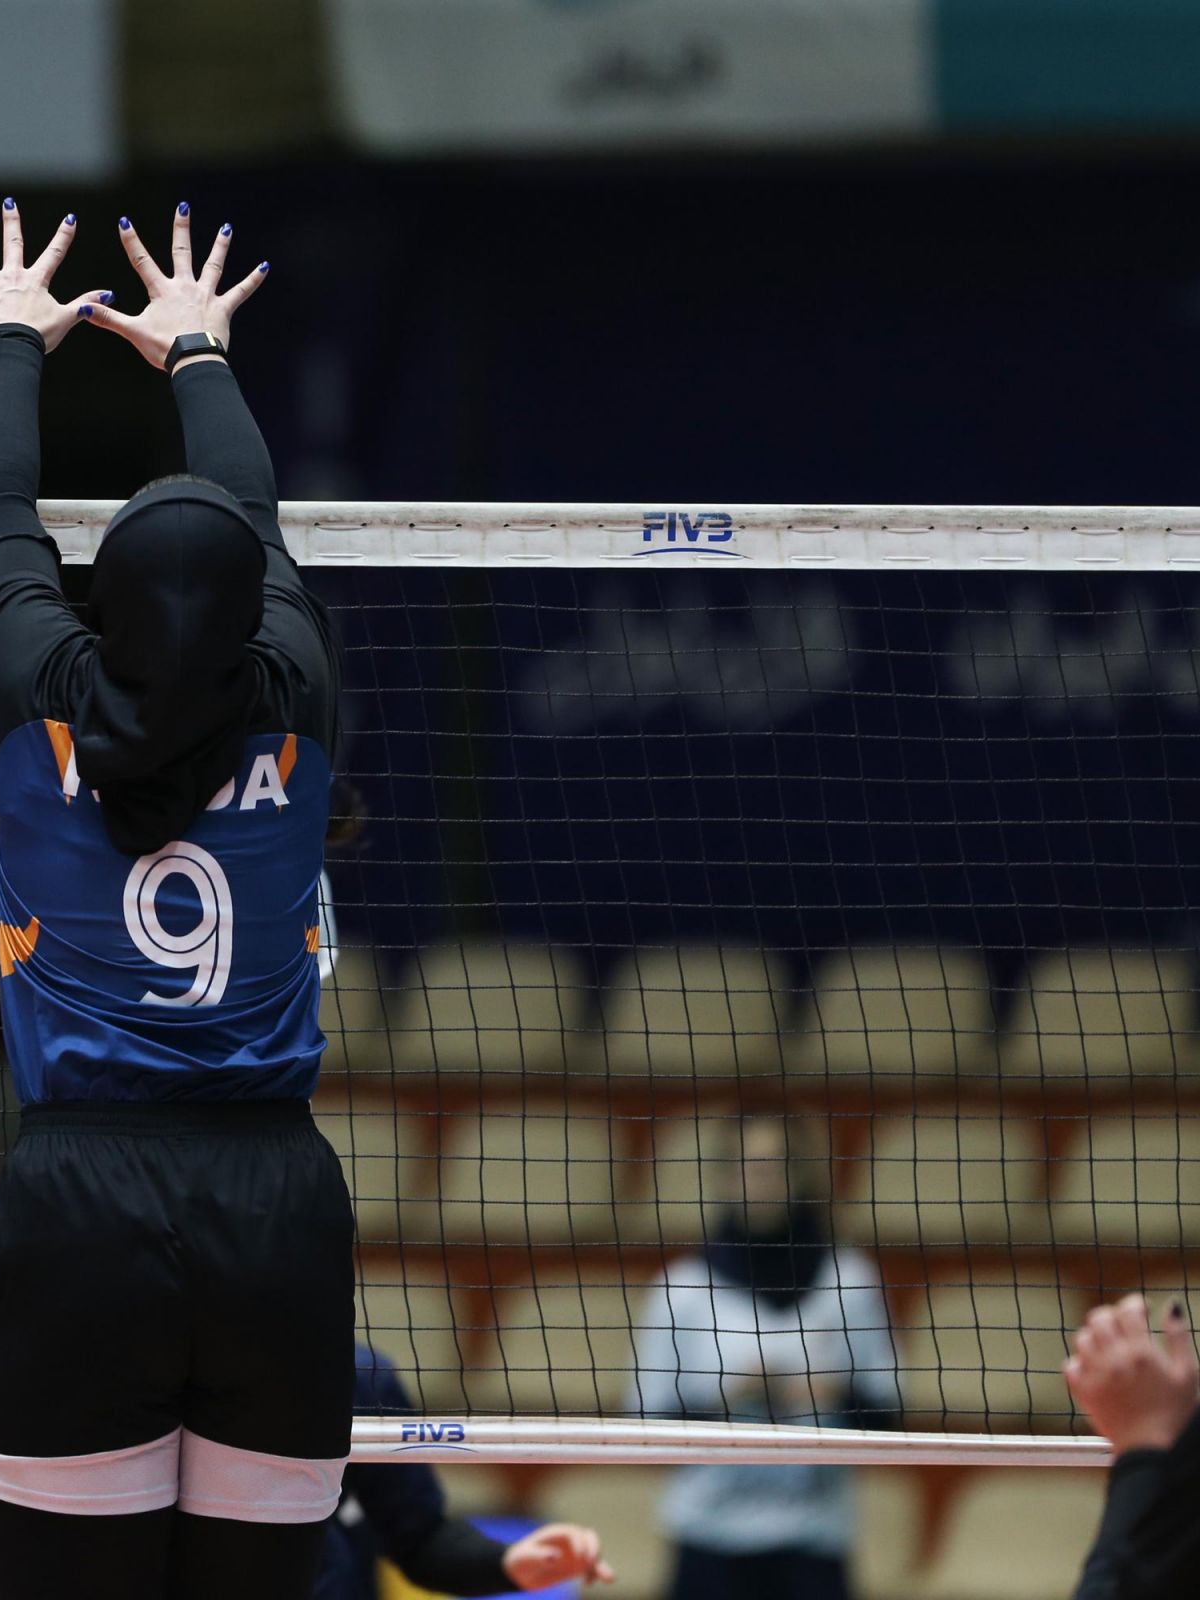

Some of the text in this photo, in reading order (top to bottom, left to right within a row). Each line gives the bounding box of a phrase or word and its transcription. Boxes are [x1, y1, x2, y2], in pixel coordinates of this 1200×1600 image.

[643, 512, 733, 542] FIVB
[123, 840, 233, 1007] 9
[401, 1423, 465, 1442] FIVB
